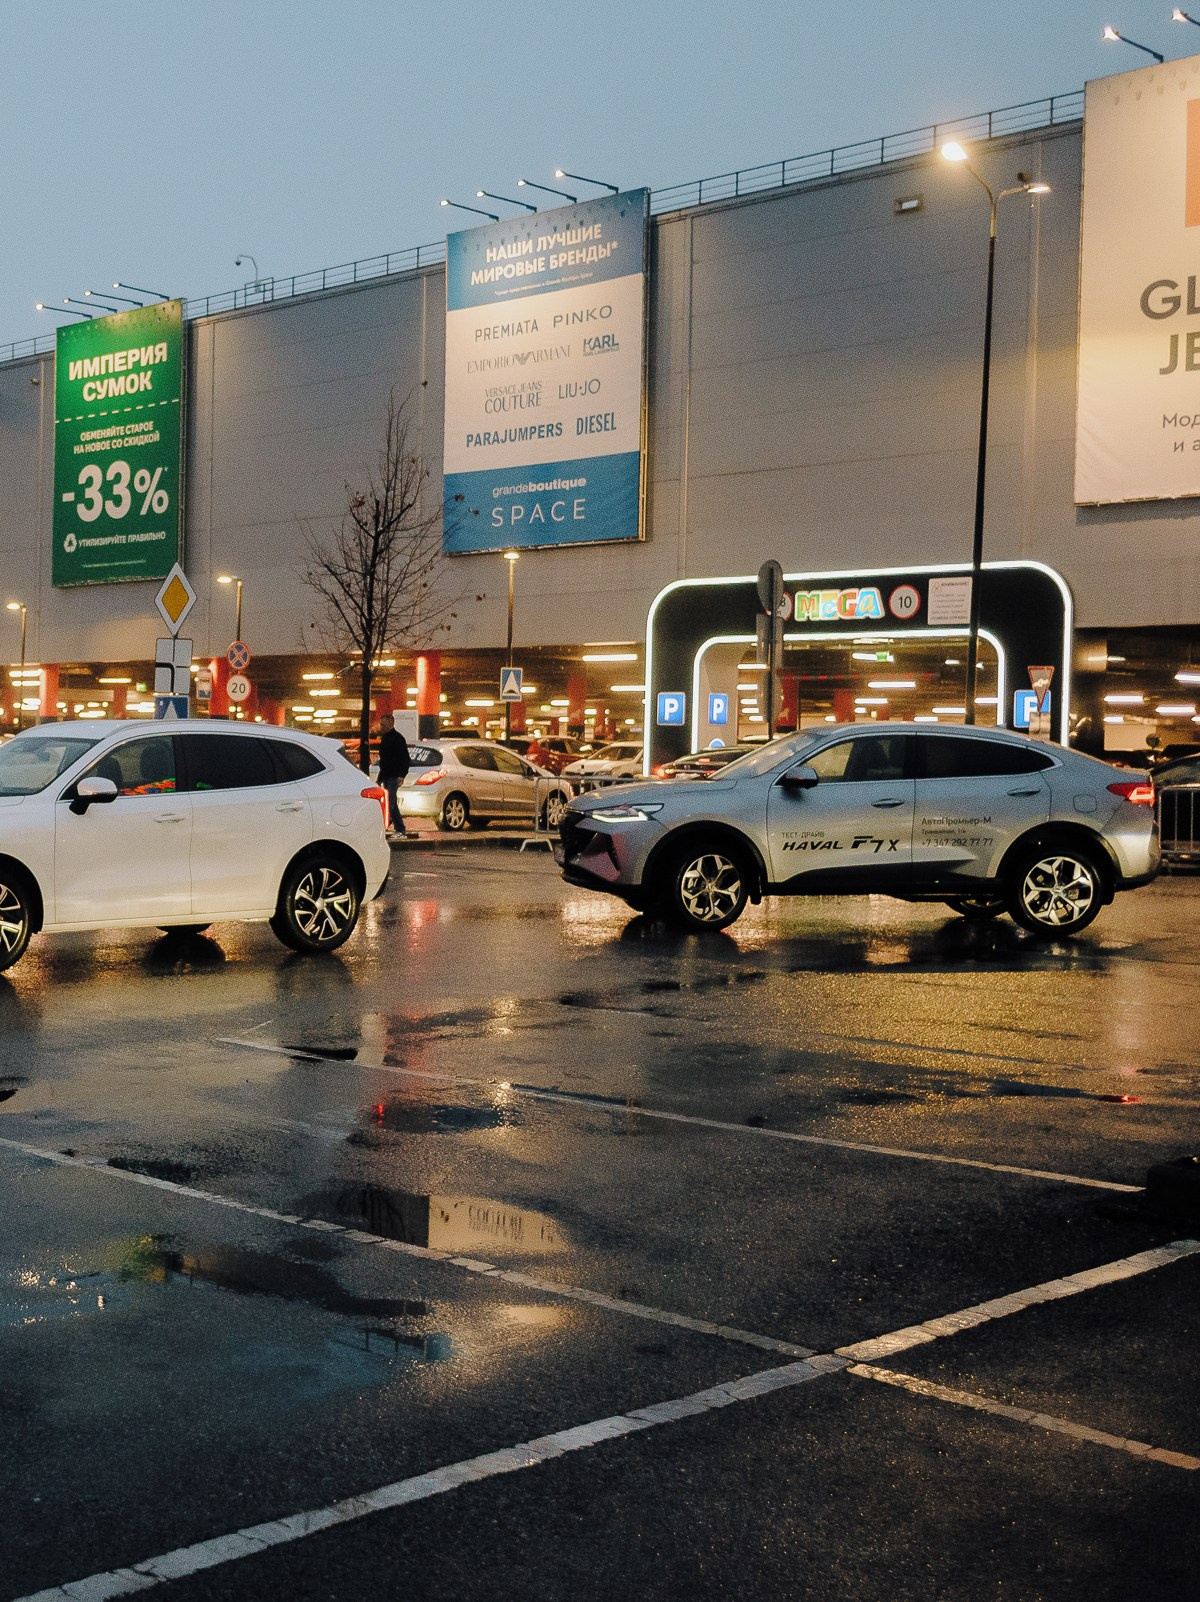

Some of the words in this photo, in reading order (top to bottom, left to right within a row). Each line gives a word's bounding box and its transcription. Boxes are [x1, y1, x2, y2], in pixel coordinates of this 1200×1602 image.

[486, 239, 533, 263] НАШИ
[536, 223, 602, 253] ЛУЧШИЕ
[471, 256, 546, 286] МИРОВЫЕ
[474, 318, 539, 343] PREMIATA
[553, 304, 613, 329] PINKO
[583, 333, 620, 353] KARL
[68, 341, 168, 381] ИМПЕРИЯ
[467, 355, 516, 375] EMPORIO
[529, 344, 571, 364] ARMANI
[82, 370, 153, 402] СУМОК
[485, 383, 517, 398] VERSACE
[518, 380, 543, 393] JEANS
[484, 391, 542, 415] COUTURE
[80, 425, 125, 442] ОБМЕНЯЙТЕ
[125, 421, 154, 435] СТАРОЕ
[466, 422, 563, 448] PARAJUMPERS
[576, 411, 617, 436] DIESEL
[73, 444, 85, 455] НА
[85, 440, 111, 453] НОВОЕ
[111, 438, 123, 449] СО
[123, 430, 160, 447] СКИДКОЙ
[1173, 440, 1184, 453] и
[492, 477, 587, 499] grandeboutique
[491, 498, 586, 527] SPACE
[79, 534, 126, 548] УТИЛИЗИРУЙТЕ
[127, 530, 166, 543] ПРАВИЛЬНО
[898, 595, 912, 609] 10
[231, 682, 246, 694] 20
[664, 698, 679, 721] P
[712, 698, 724, 721] P
[782, 831, 825, 839] ТЕСТ-ДРАЙВ
[782, 840, 844, 851] HAVAL
[951, 838, 967, 847] 292
[969, 837, 980, 846] 77
[983, 837, 994, 846] 77
